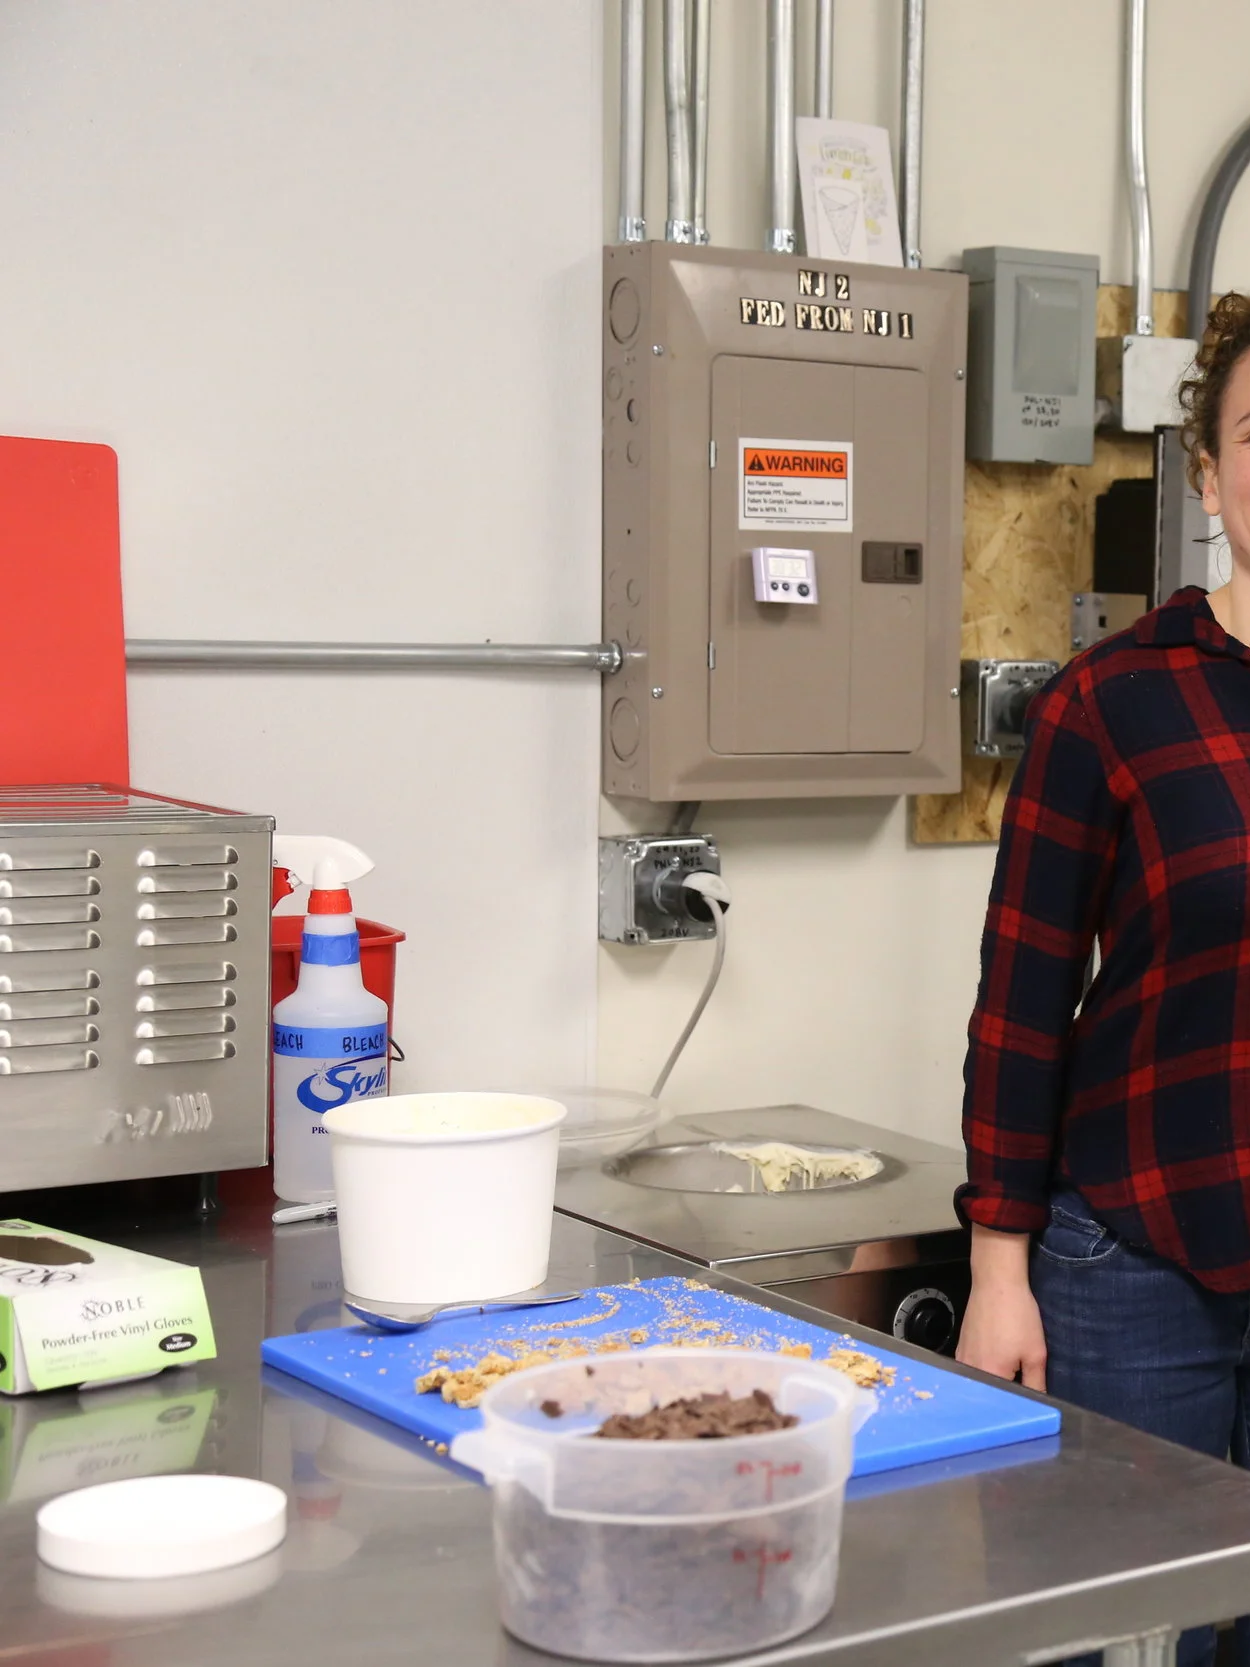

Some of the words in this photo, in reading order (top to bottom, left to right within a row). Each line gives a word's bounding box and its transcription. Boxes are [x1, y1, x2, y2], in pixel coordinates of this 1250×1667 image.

[799, 270, 826, 297] NJ
[836, 275, 849, 300] 2
[741, 298, 786, 327] FED
[795, 303, 854, 333] FROM
[863, 309, 889, 336] NJ
[901, 314, 912, 338] 1
[765, 455, 844, 473] WARNING
[342, 1032, 385, 1053] BLEACH
[83, 1295, 146, 1320] NOBLE
[41, 1324, 118, 1350] Powder-Free
[120, 1320, 151, 1338] Vinyl
[153, 1316, 193, 1331] Gloves
[166, 1340, 191, 1351] Medium
